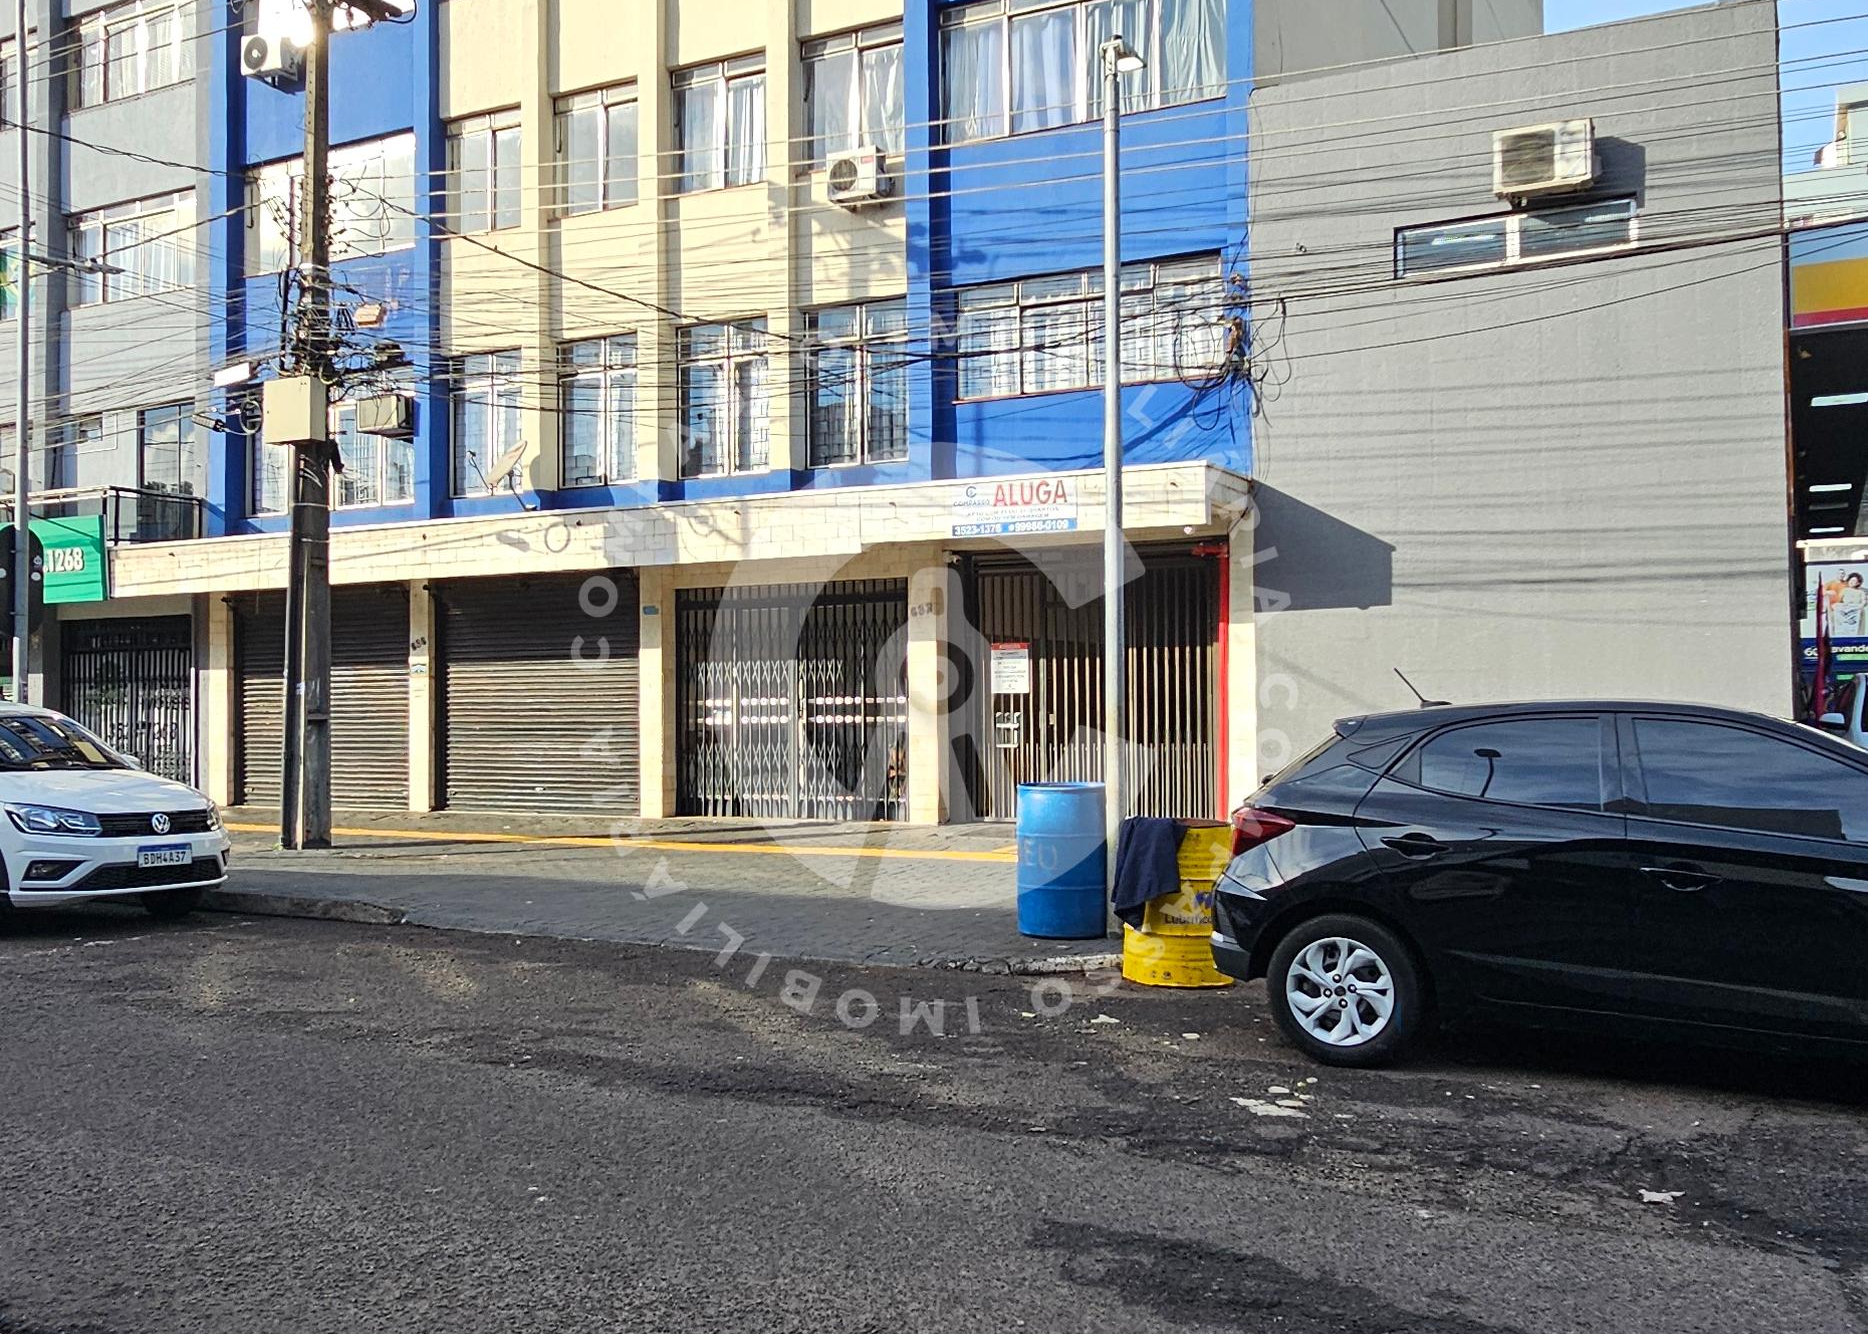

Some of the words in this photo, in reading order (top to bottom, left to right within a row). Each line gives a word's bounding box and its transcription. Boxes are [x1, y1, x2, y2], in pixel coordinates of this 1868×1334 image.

[993, 479, 1068, 507] ALUGA
[953, 499, 990, 507] COMPASSO
[143, 851, 187, 865] BDH4A37
